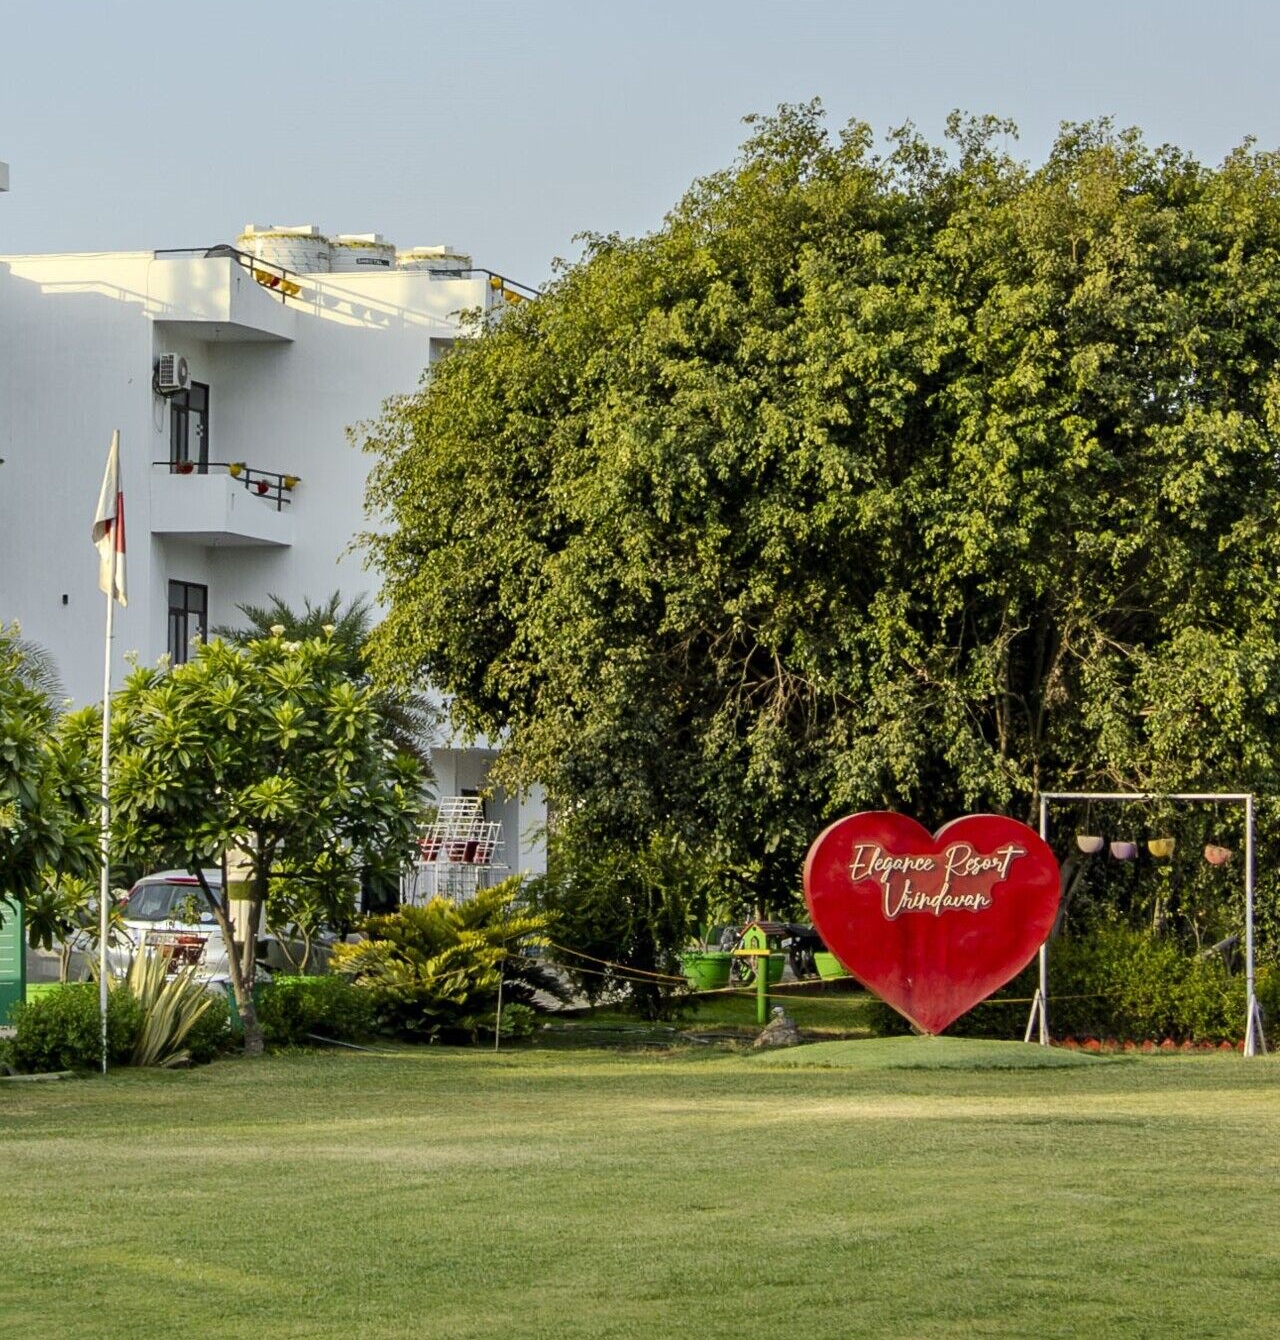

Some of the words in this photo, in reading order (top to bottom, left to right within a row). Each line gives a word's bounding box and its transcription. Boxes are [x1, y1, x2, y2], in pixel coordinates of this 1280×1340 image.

[848, 844, 934, 883] Elegance
[945, 844, 1025, 882] Resort
[884, 879, 992, 917] Vrindavan
